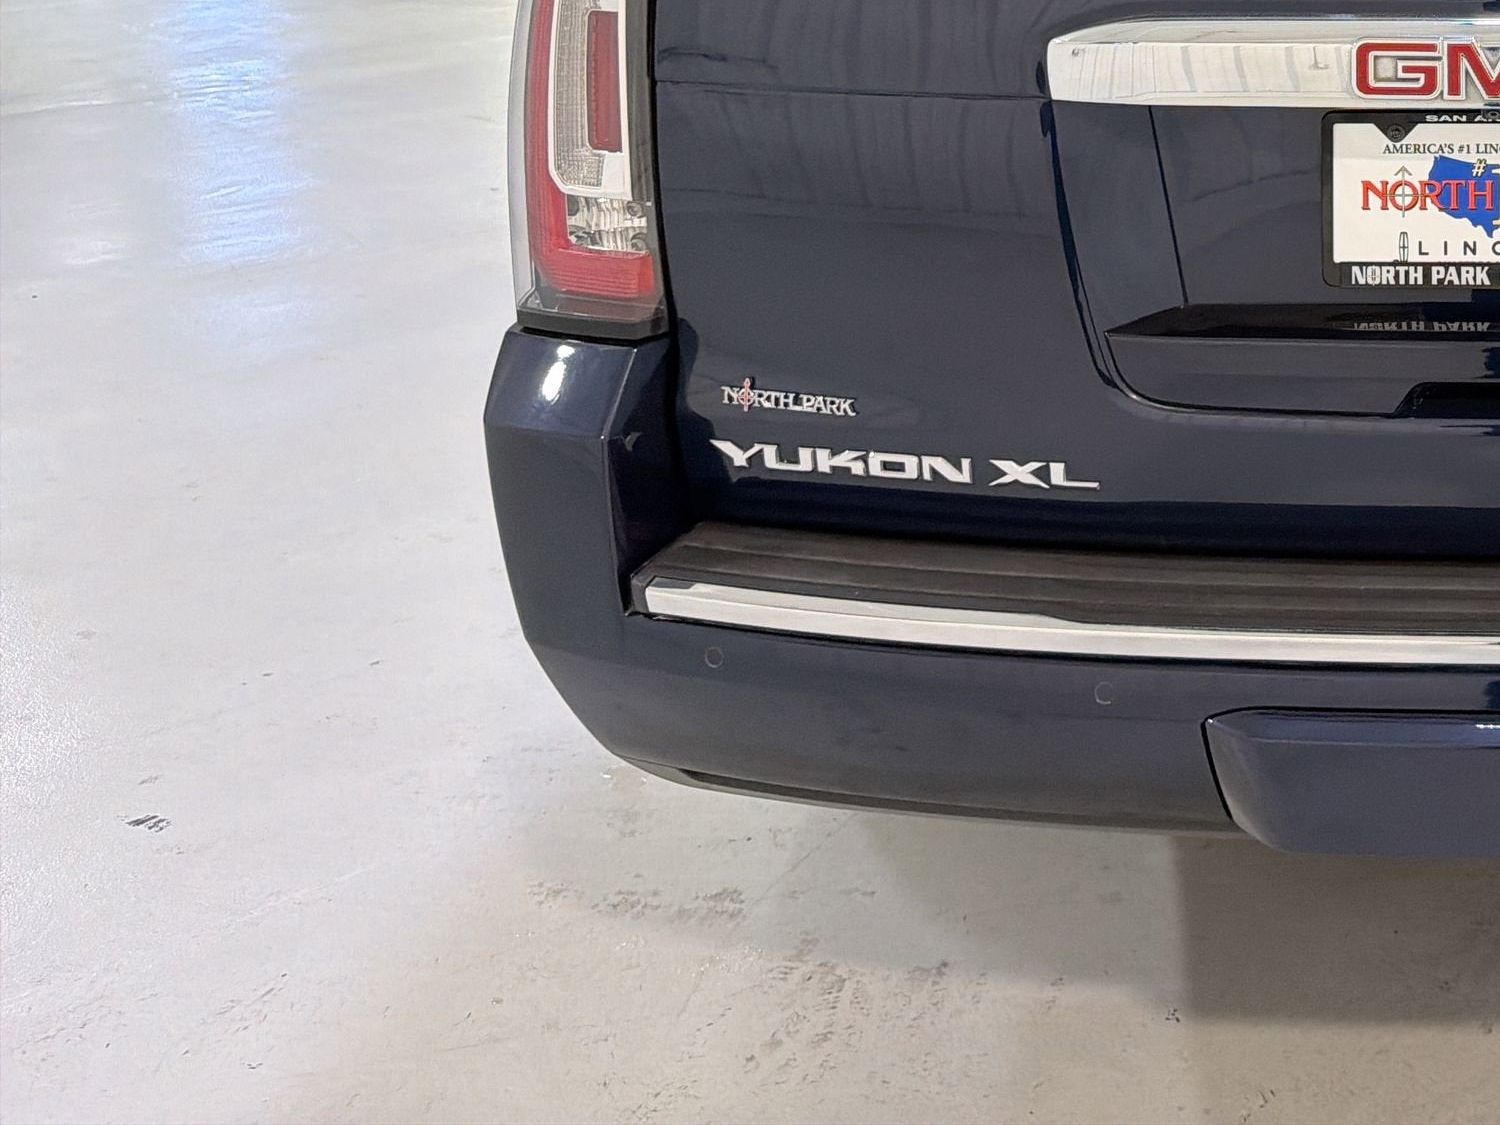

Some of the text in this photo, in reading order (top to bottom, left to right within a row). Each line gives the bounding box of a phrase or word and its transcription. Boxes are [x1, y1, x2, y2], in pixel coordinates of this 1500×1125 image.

[1425, 114, 1467, 122] SAN
[1382, 143, 1455, 155] AMERICA'S
[1457, 143, 1471, 155] #1
[1361, 179, 1495, 211] NORTH
[1351, 265, 1424, 286] NORTH
[1431, 265, 1491, 286] PARK
[721, 385, 857, 417] NORTH PARK
[709, 438, 1100, 490] YUKON XL
